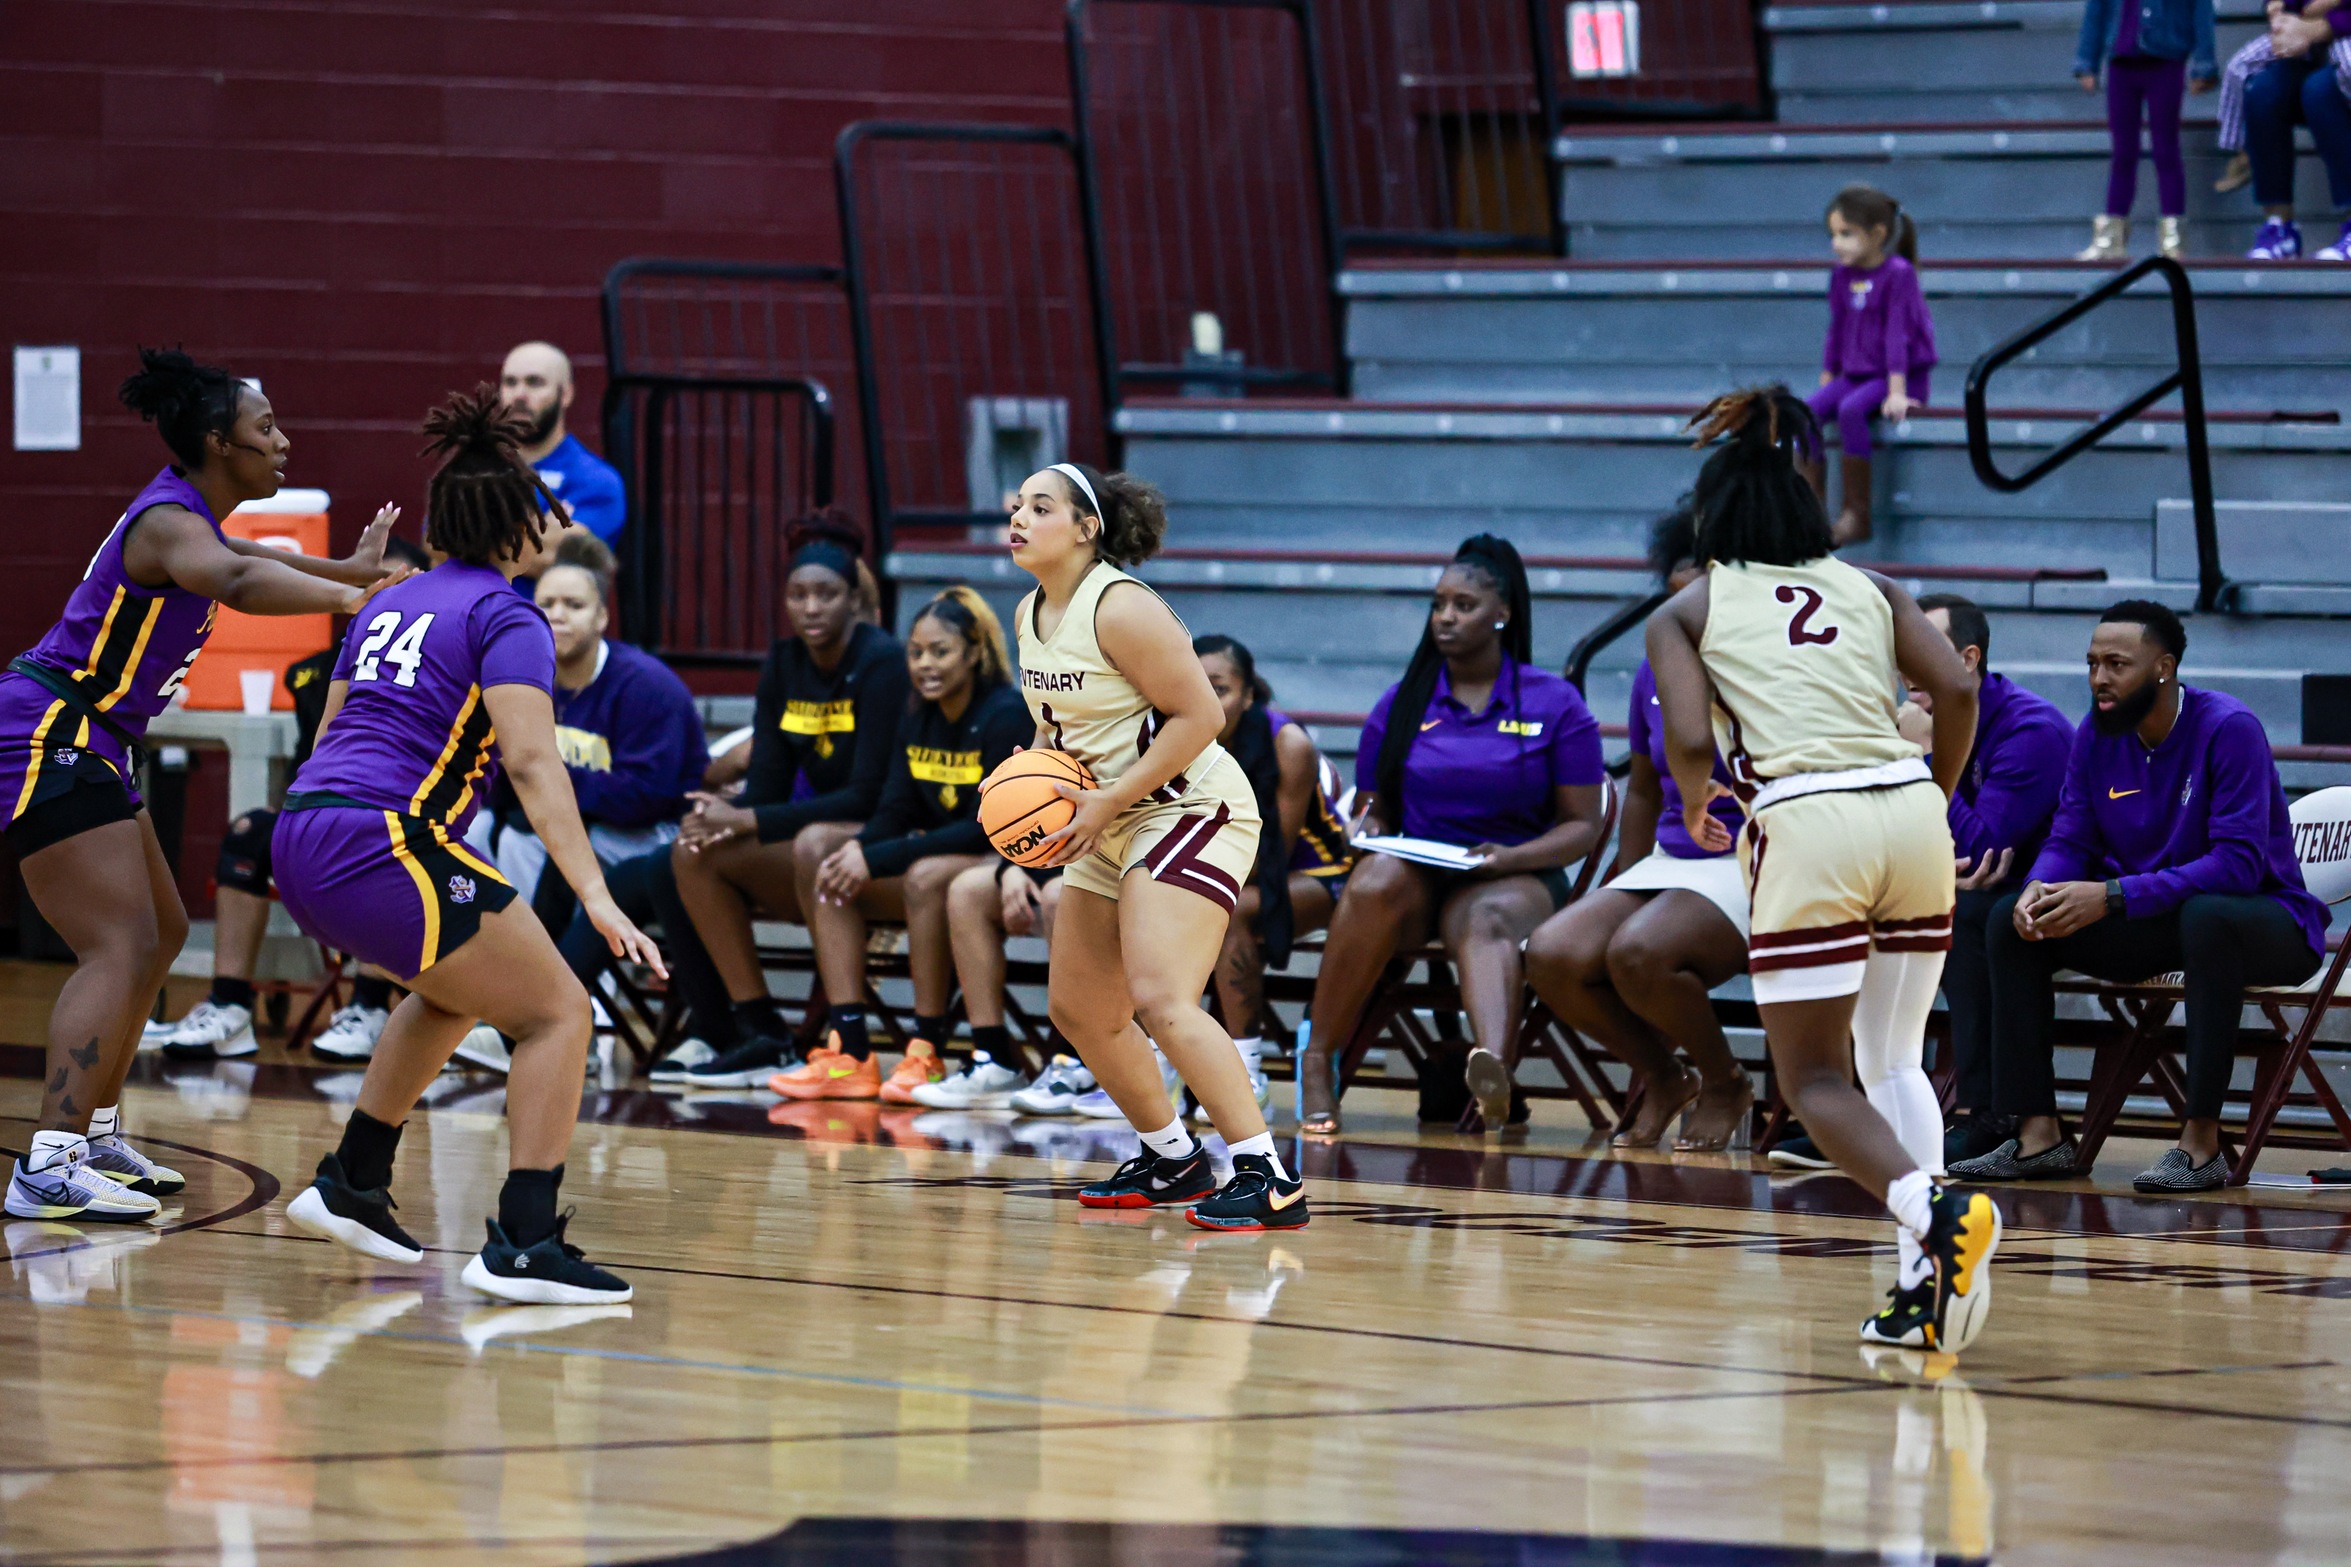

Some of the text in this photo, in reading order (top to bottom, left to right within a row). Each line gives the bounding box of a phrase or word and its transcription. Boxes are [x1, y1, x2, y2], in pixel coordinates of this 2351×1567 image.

[1774, 584, 1839, 647] 2
[354, 610, 437, 688] 24
[1000, 824, 1048, 858] NCAA
